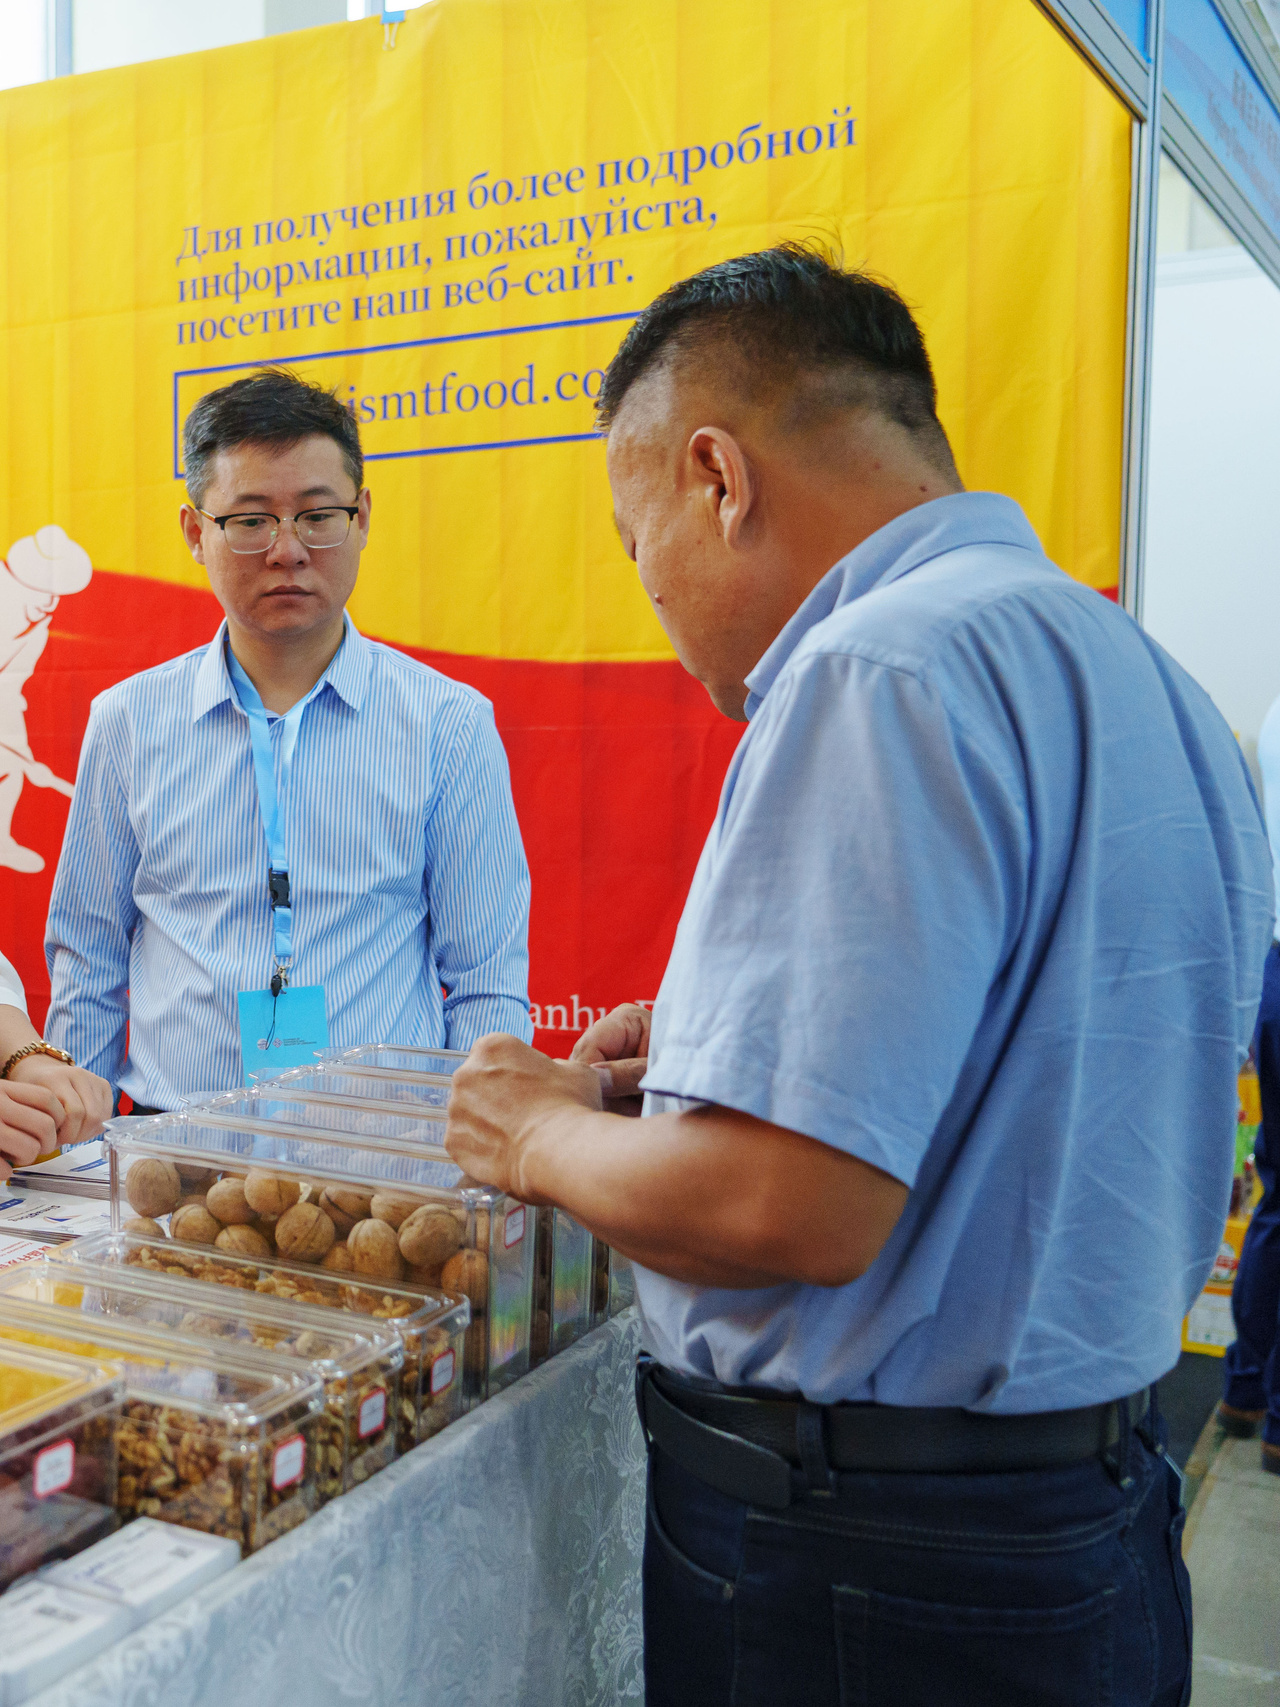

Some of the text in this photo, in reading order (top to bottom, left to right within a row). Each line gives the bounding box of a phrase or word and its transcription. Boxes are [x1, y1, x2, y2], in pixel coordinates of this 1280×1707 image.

[176, 105, 858, 265] Для получения более подробной
[178, 246, 635, 345] посетите наш веб-сайт.
[179, 196, 718, 304] информации, пожалуйста,
